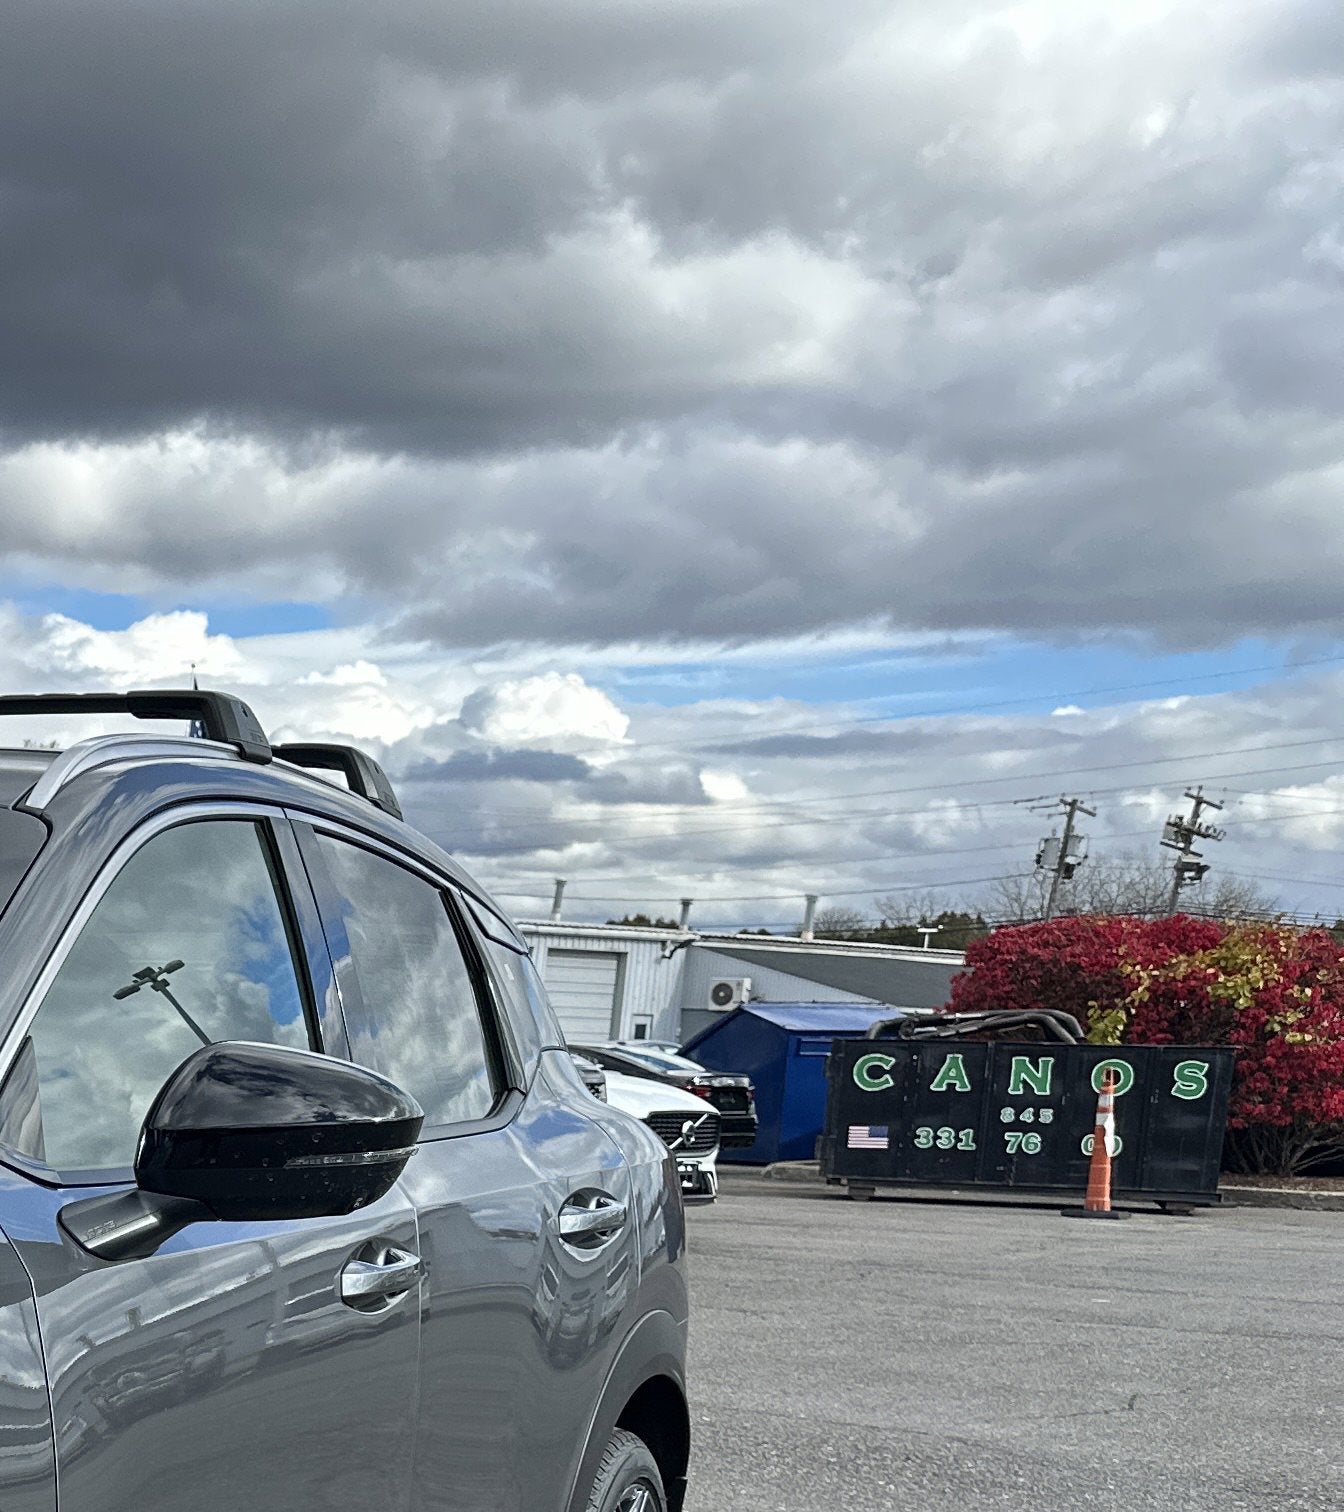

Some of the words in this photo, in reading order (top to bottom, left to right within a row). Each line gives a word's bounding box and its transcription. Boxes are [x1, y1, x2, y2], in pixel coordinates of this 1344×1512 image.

[1000, 1107, 1054, 1124] 845
[914, 1127, 977, 1151] 331
[1004, 1132, 1042, 1155] 76
